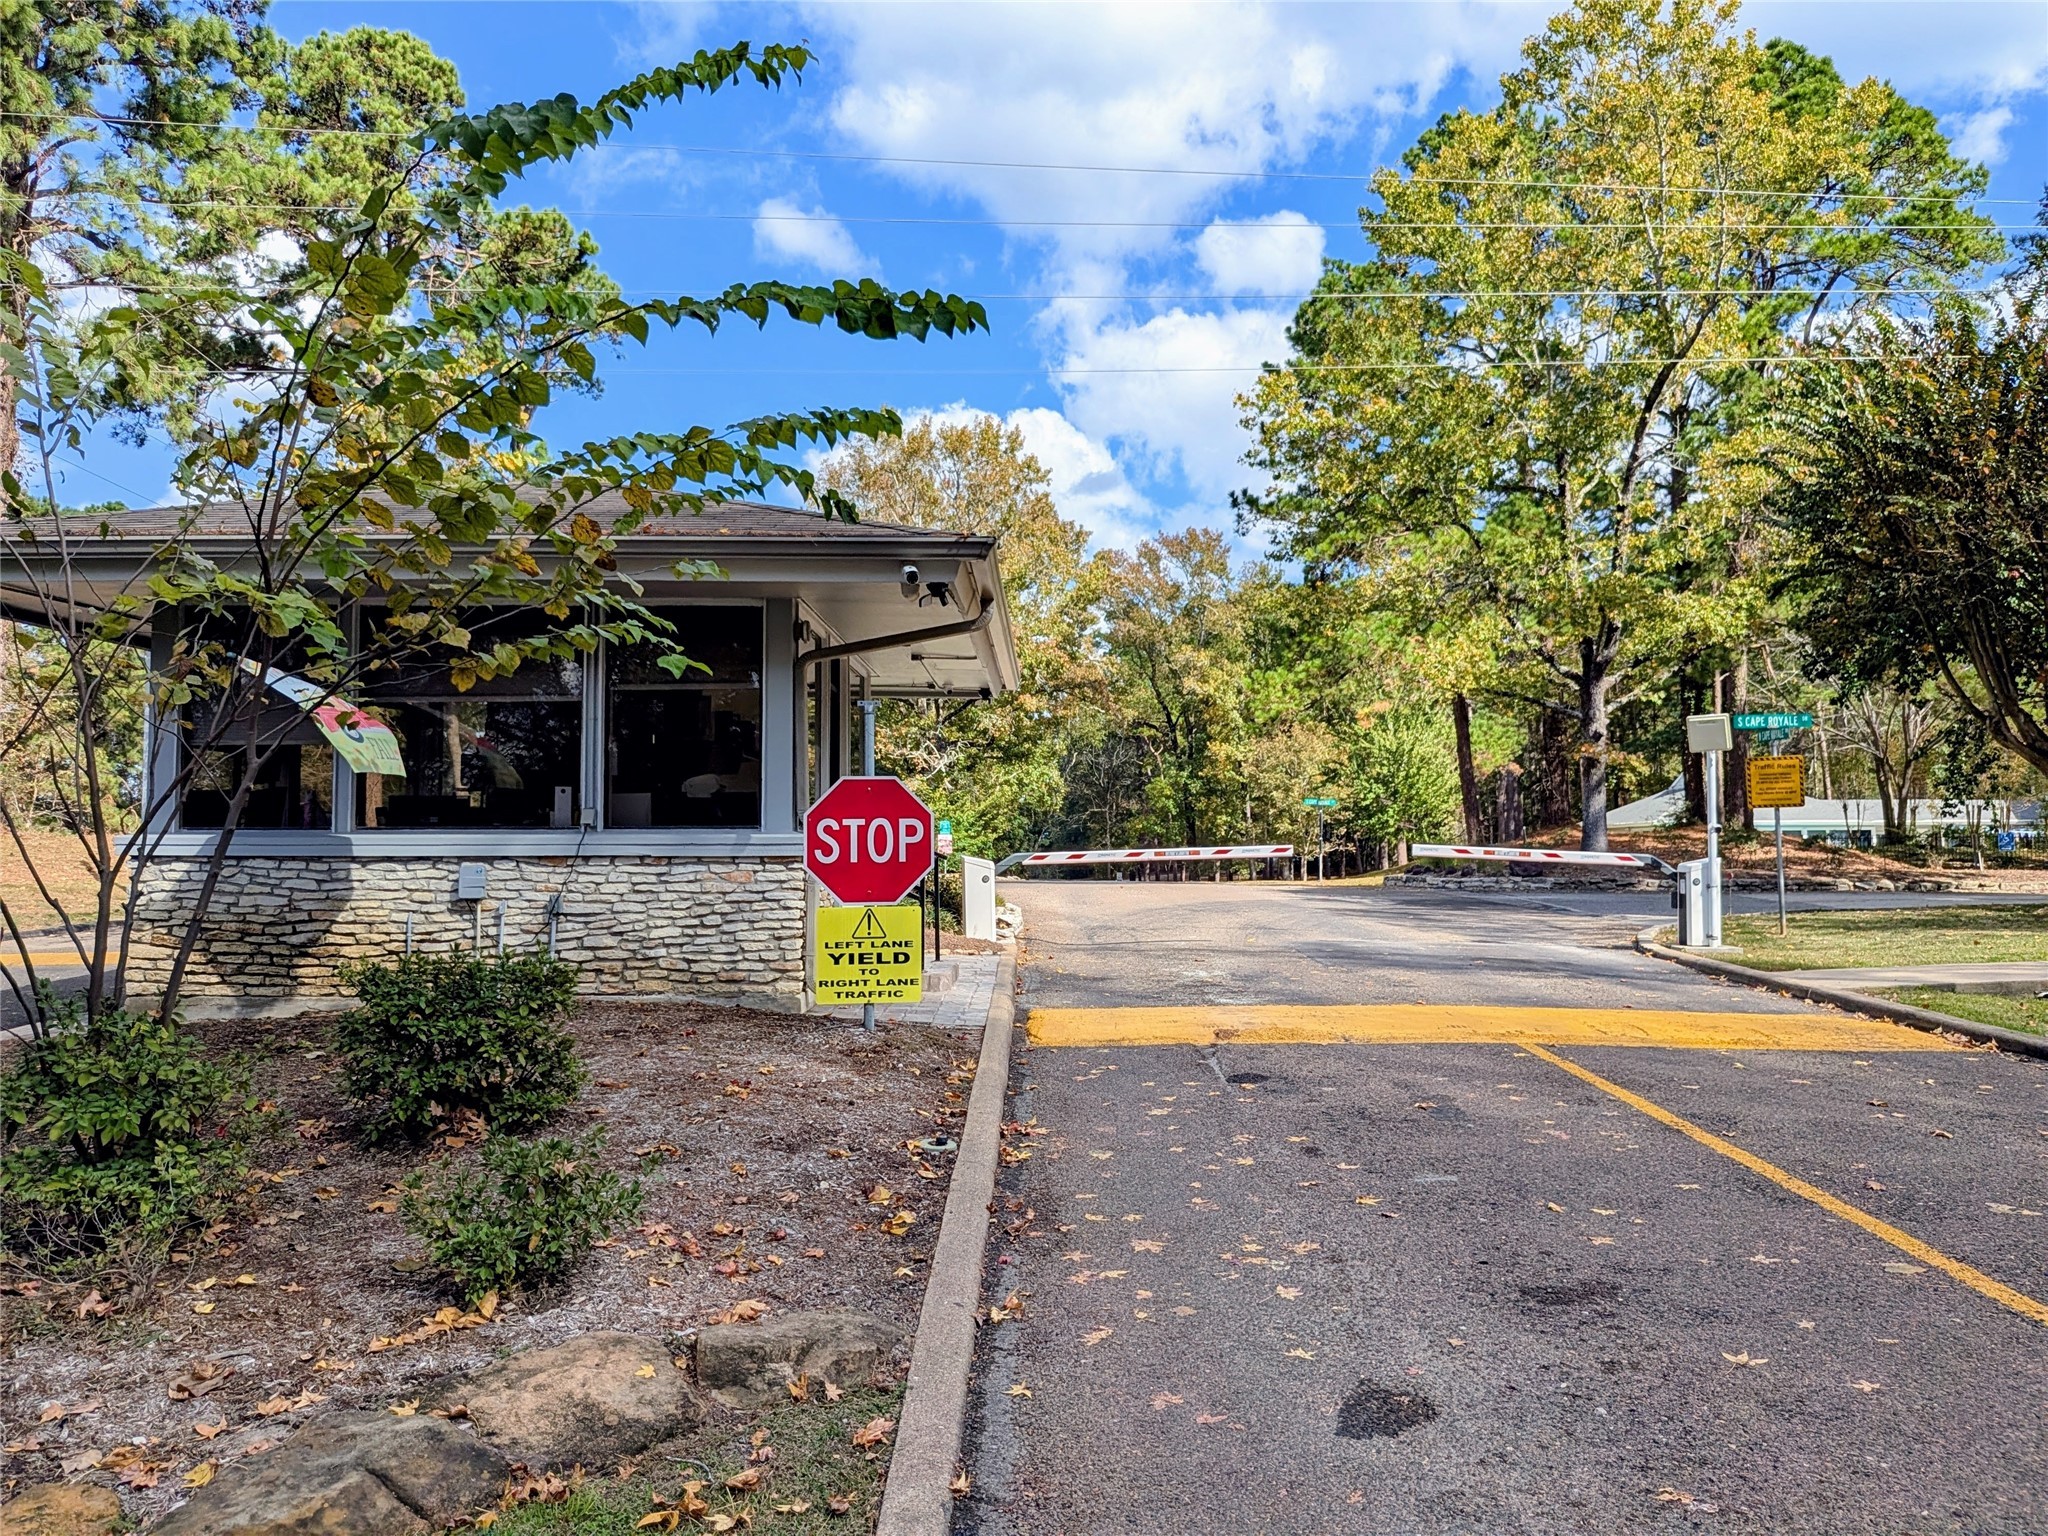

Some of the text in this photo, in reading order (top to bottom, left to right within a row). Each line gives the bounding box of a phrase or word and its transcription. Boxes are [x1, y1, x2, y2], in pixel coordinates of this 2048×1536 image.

[1738, 716, 1743, 727] S
[1745, 716, 1766, 727] CAPE
[1768, 715, 1799, 727] ROYALE
[365, 736, 400, 761] FALL
[814, 818, 925, 864] STOP
[824, 940, 914, 949] LEFT LANE
[827, 952, 911, 966] YIELD
[858, 968, 880, 976] TO
[818, 978, 920, 988] RIGHT LANE
[834, 990, 904, 999] TRAFFIC
